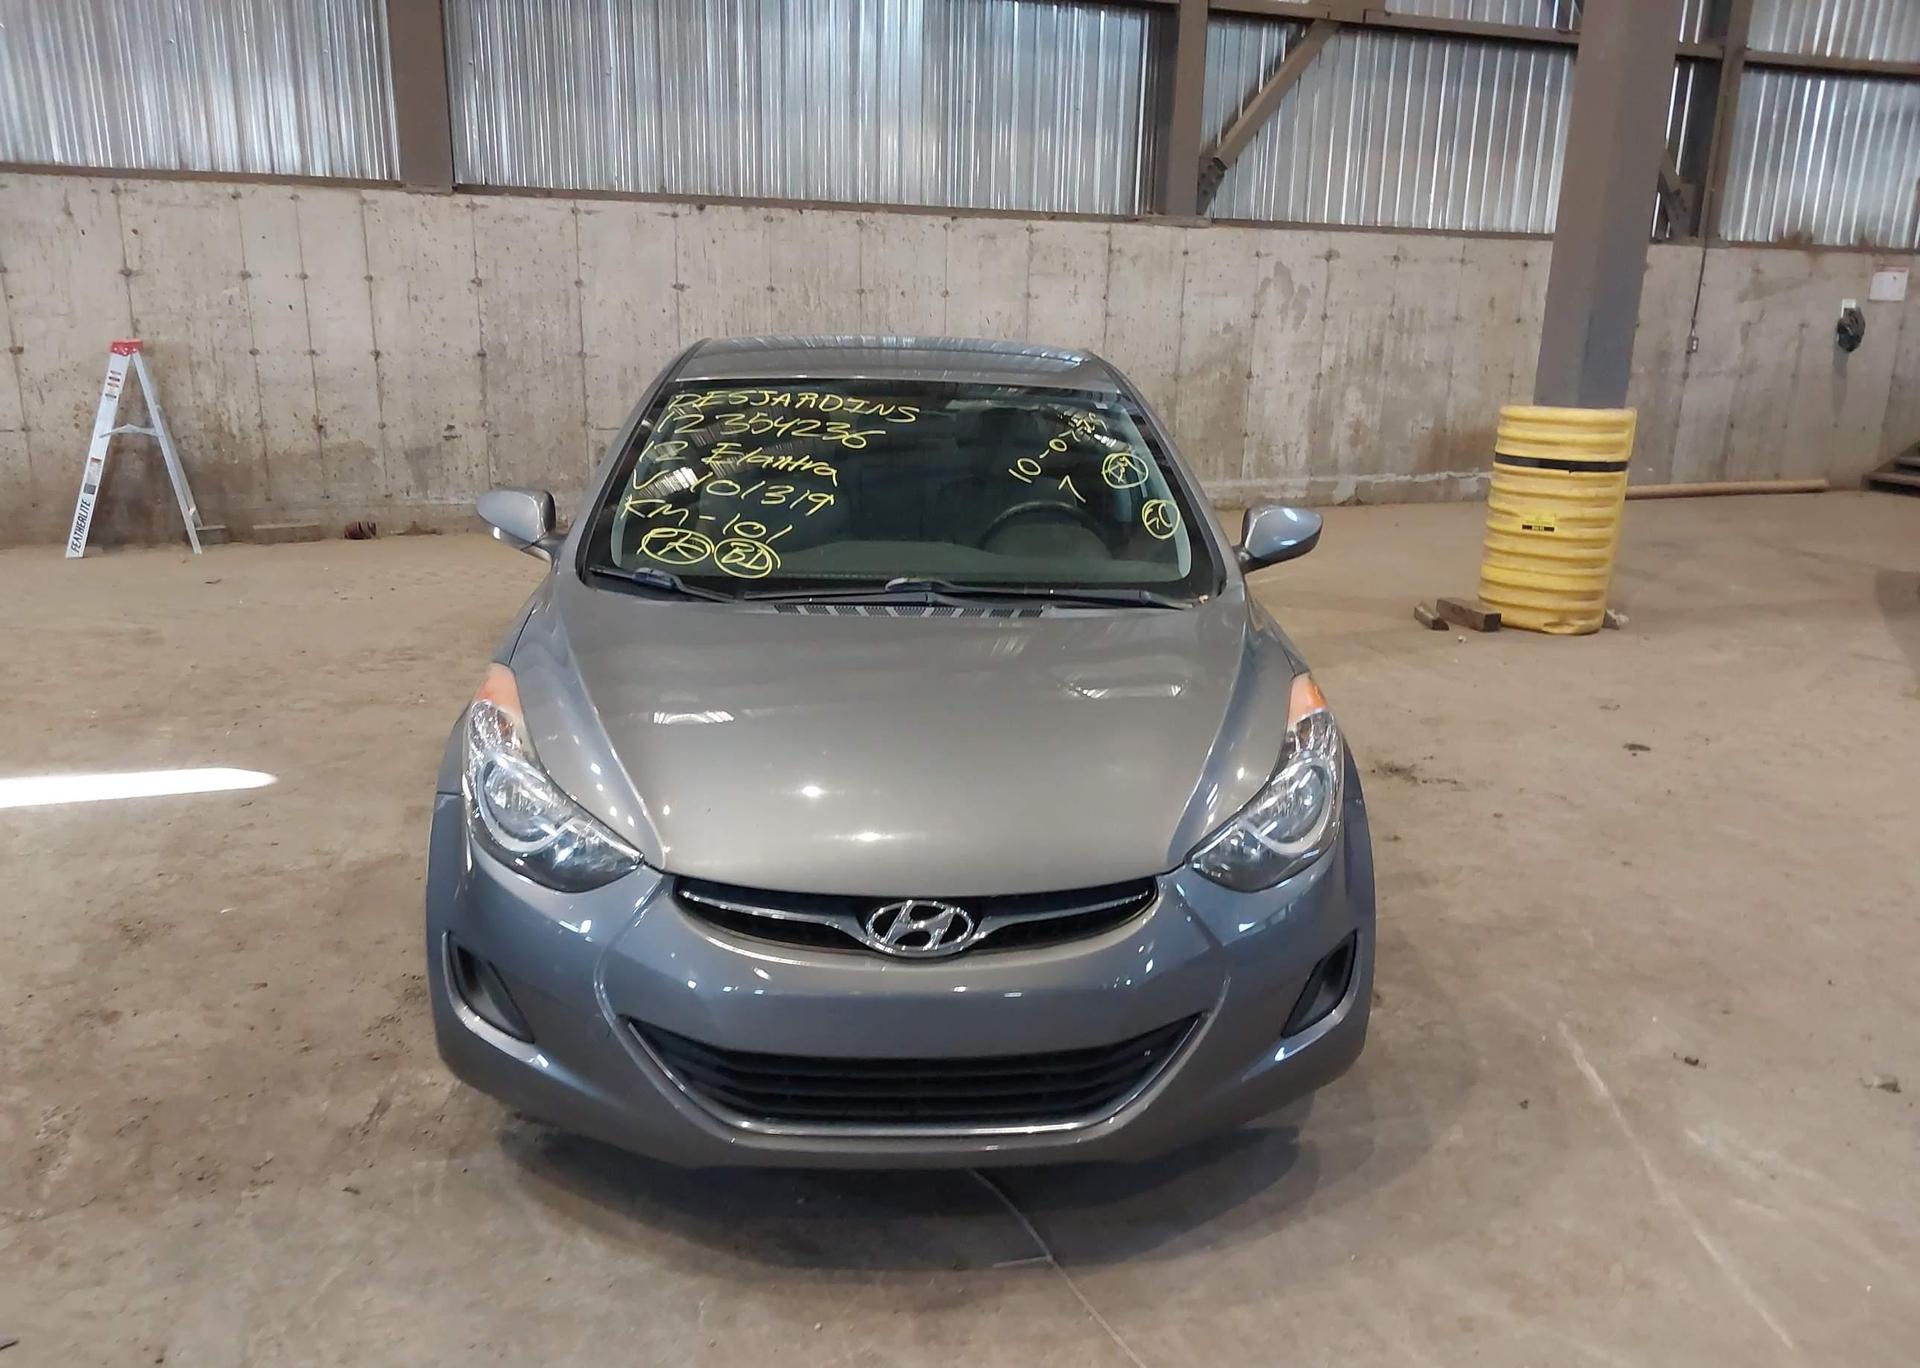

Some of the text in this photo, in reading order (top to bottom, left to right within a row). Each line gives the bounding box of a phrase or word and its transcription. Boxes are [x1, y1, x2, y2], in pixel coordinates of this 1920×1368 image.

[668, 390, 920, 423] DESJARDINS
[701, 442, 839, 487] Elantra
[70, 498, 92, 554] FEATHERLITE
